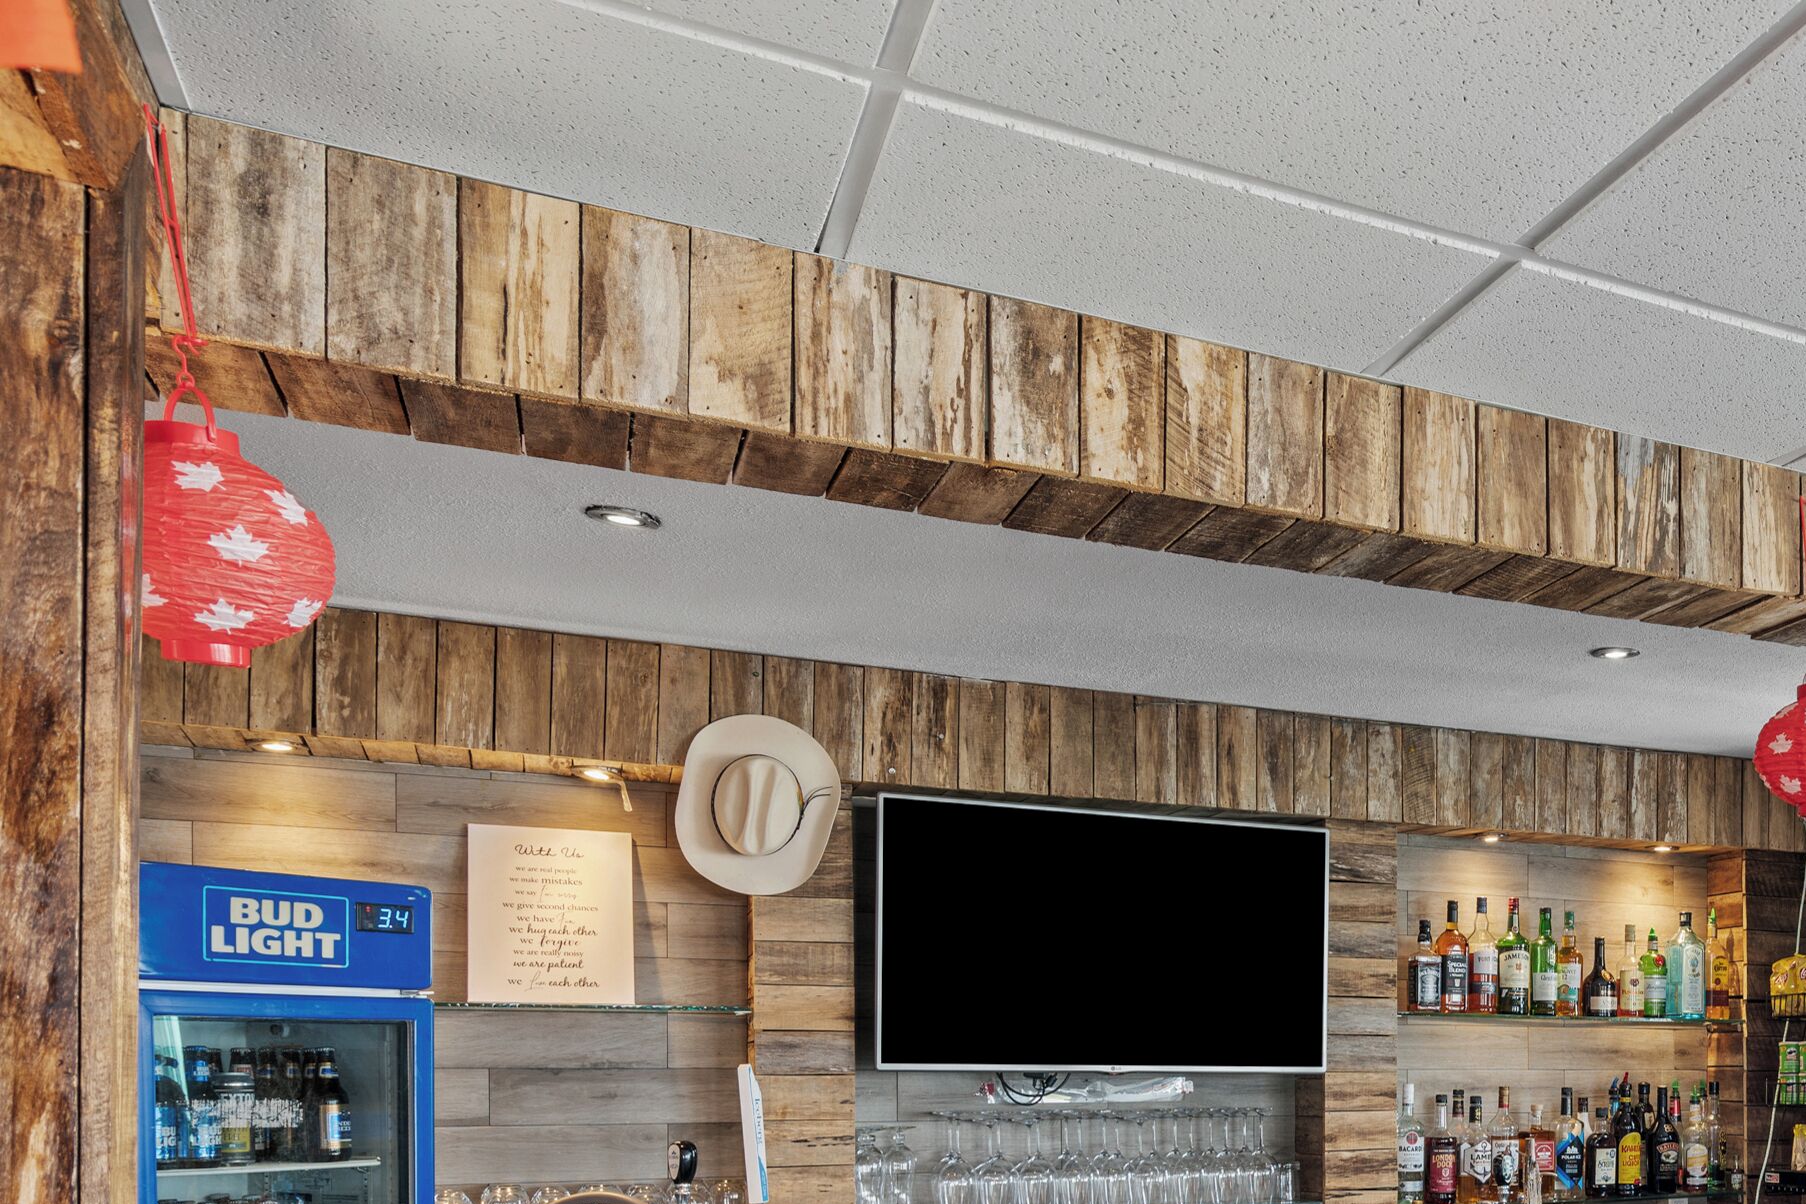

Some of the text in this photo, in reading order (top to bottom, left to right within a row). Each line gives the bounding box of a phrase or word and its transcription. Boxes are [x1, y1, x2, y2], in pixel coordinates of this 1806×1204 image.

[514, 844, 585, 858] With Us
[554, 868, 577, 876] people
[541, 876, 583, 886] mistakes
[229, 896, 324, 929] BUD
[516, 900, 534, 910] give
[536, 900, 565, 910] second
[567, 902, 600, 912] chances
[378, 908, 409, 928] 3.4
[533, 913, 555, 923] have
[526, 924, 546, 938] hug
[548, 926, 570, 936] each
[572, 926, 598, 936] other
[210, 924, 341, 959] LIGHT
[540, 935, 580, 950] forgive
[540, 949, 561, 958] really
[547, 958, 584, 972] patient
[548, 976, 572, 987] each
[574, 976, 600, 988] other
[1432, 1154, 1456, 1163] LONDON
